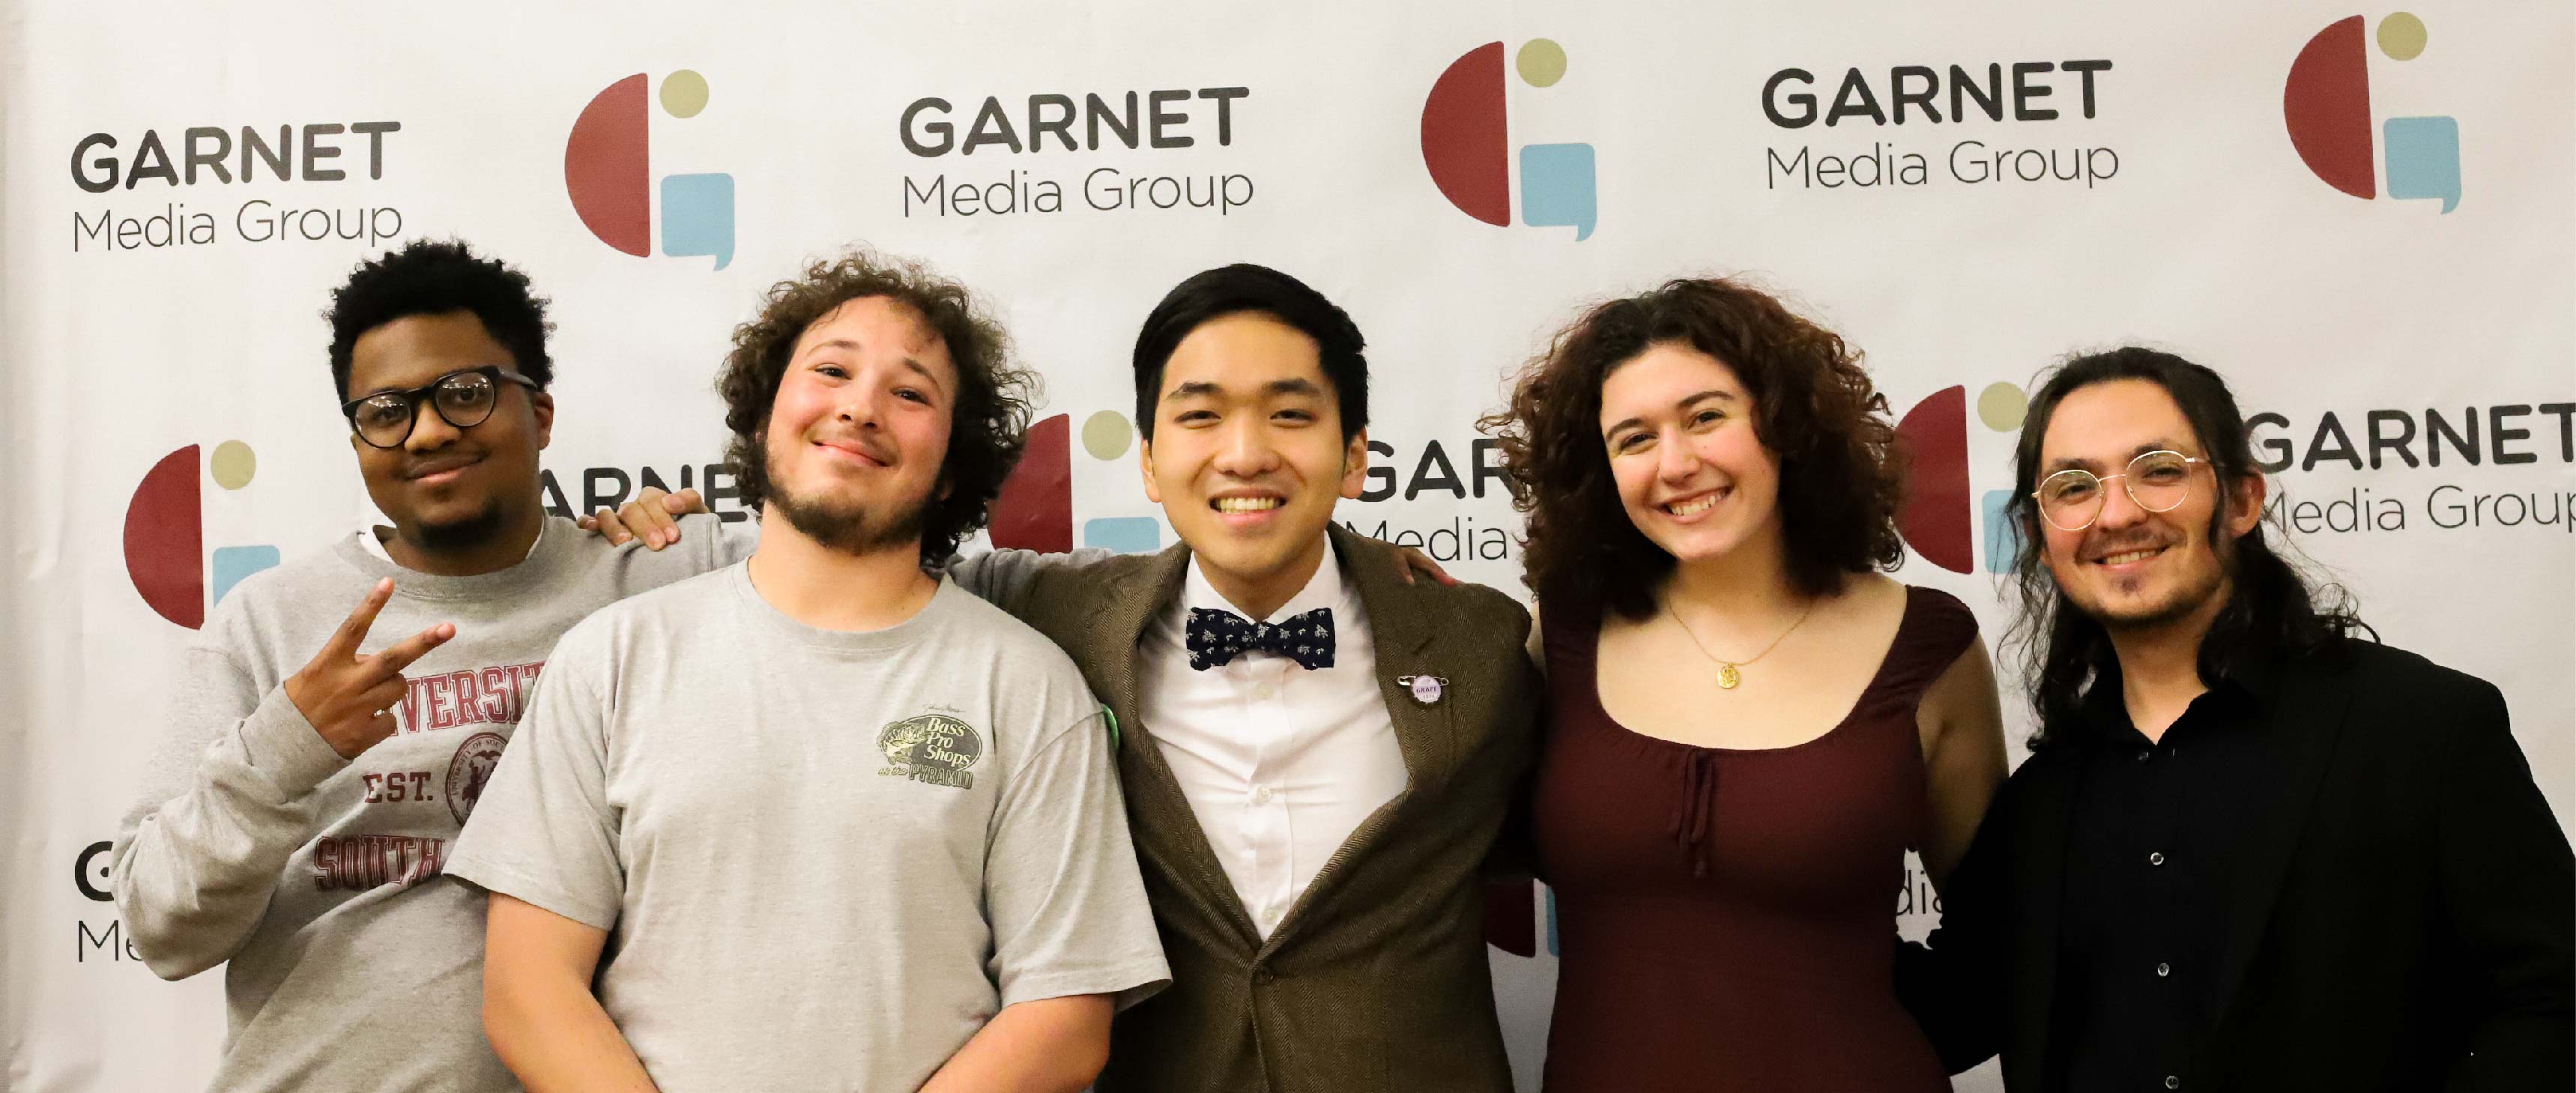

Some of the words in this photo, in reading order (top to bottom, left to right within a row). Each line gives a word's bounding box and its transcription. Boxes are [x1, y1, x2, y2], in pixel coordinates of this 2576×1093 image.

[1762, 60, 2112, 128] GARNET
[901, 87, 1249, 157] GARNET
[71, 121, 401, 193] GARNET
[1768, 142, 1926, 189] Media
[1950, 141, 2119, 189] Group
[904, 170, 1062, 218] Media
[1084, 168, 1254, 216] Group
[73, 204, 215, 252] Media
[237, 200, 402, 247] Group
[2245, 403, 2576, 474] GARNET
[926, 717, 966, 737] Bass
[926, 731, 954, 748] Pro
[909, 763, 973, 790] PYRAMID
[924, 745, 971, 767] Shops
[363, 772, 433, 804] EST.
